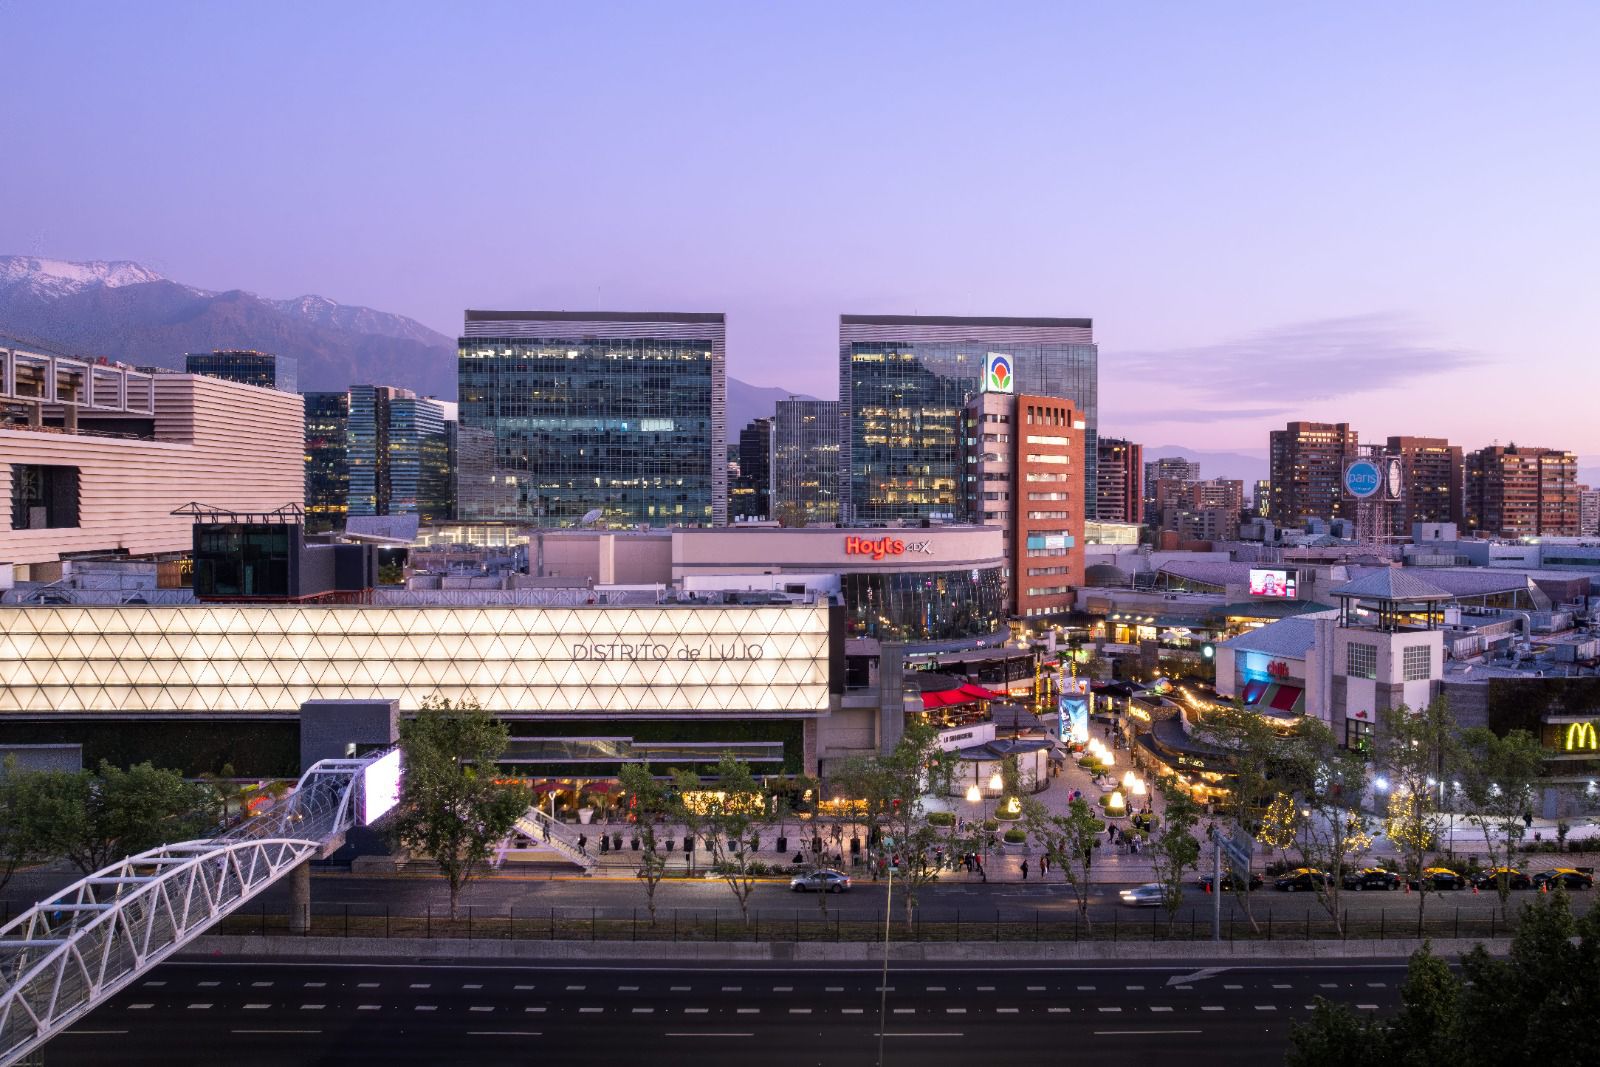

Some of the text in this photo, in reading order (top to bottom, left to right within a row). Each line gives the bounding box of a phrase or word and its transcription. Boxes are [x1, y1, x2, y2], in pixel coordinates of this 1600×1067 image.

[846, 536, 934, 560] Hoyts 4DX
[573, 644, 764, 661] DISTRITO de LUJO
